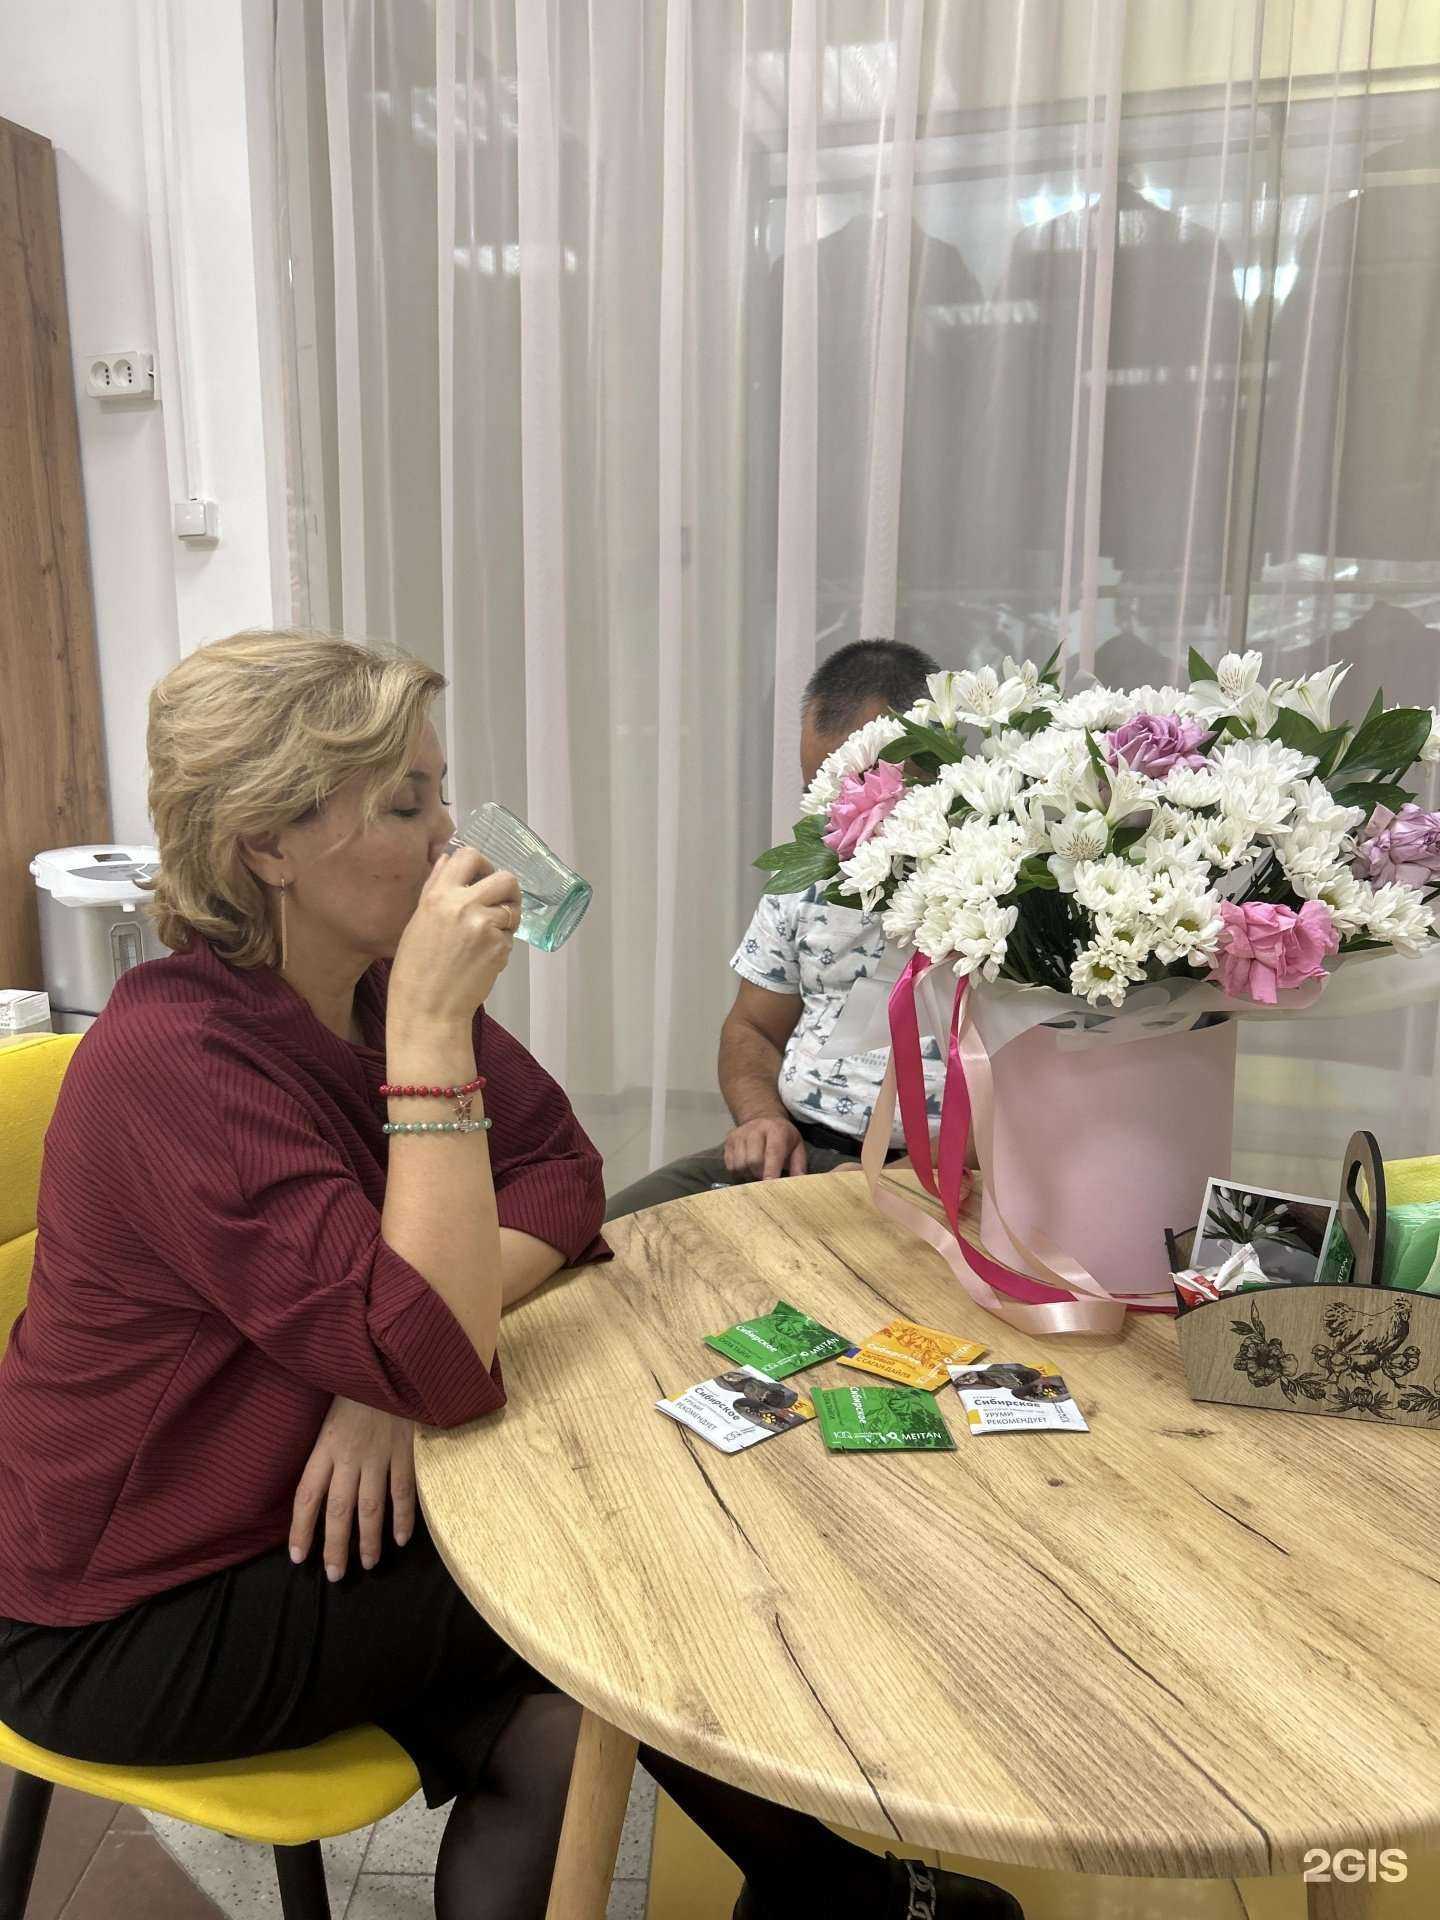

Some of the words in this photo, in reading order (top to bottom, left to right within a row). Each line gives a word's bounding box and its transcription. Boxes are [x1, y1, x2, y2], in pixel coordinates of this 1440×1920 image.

[735, 1325, 778, 1353] Сибирское
[810, 1336, 840, 1355] MEITAN
[694, 1387, 741, 1421] Сибирское
[849, 1386, 867, 1424] Сибирское
[974, 1398, 1041, 1408] Сибирское
[986, 1417, 1047, 1425] РЕКОМЕНДУЕТ
[901, 1431, 942, 1441] MEITAN
